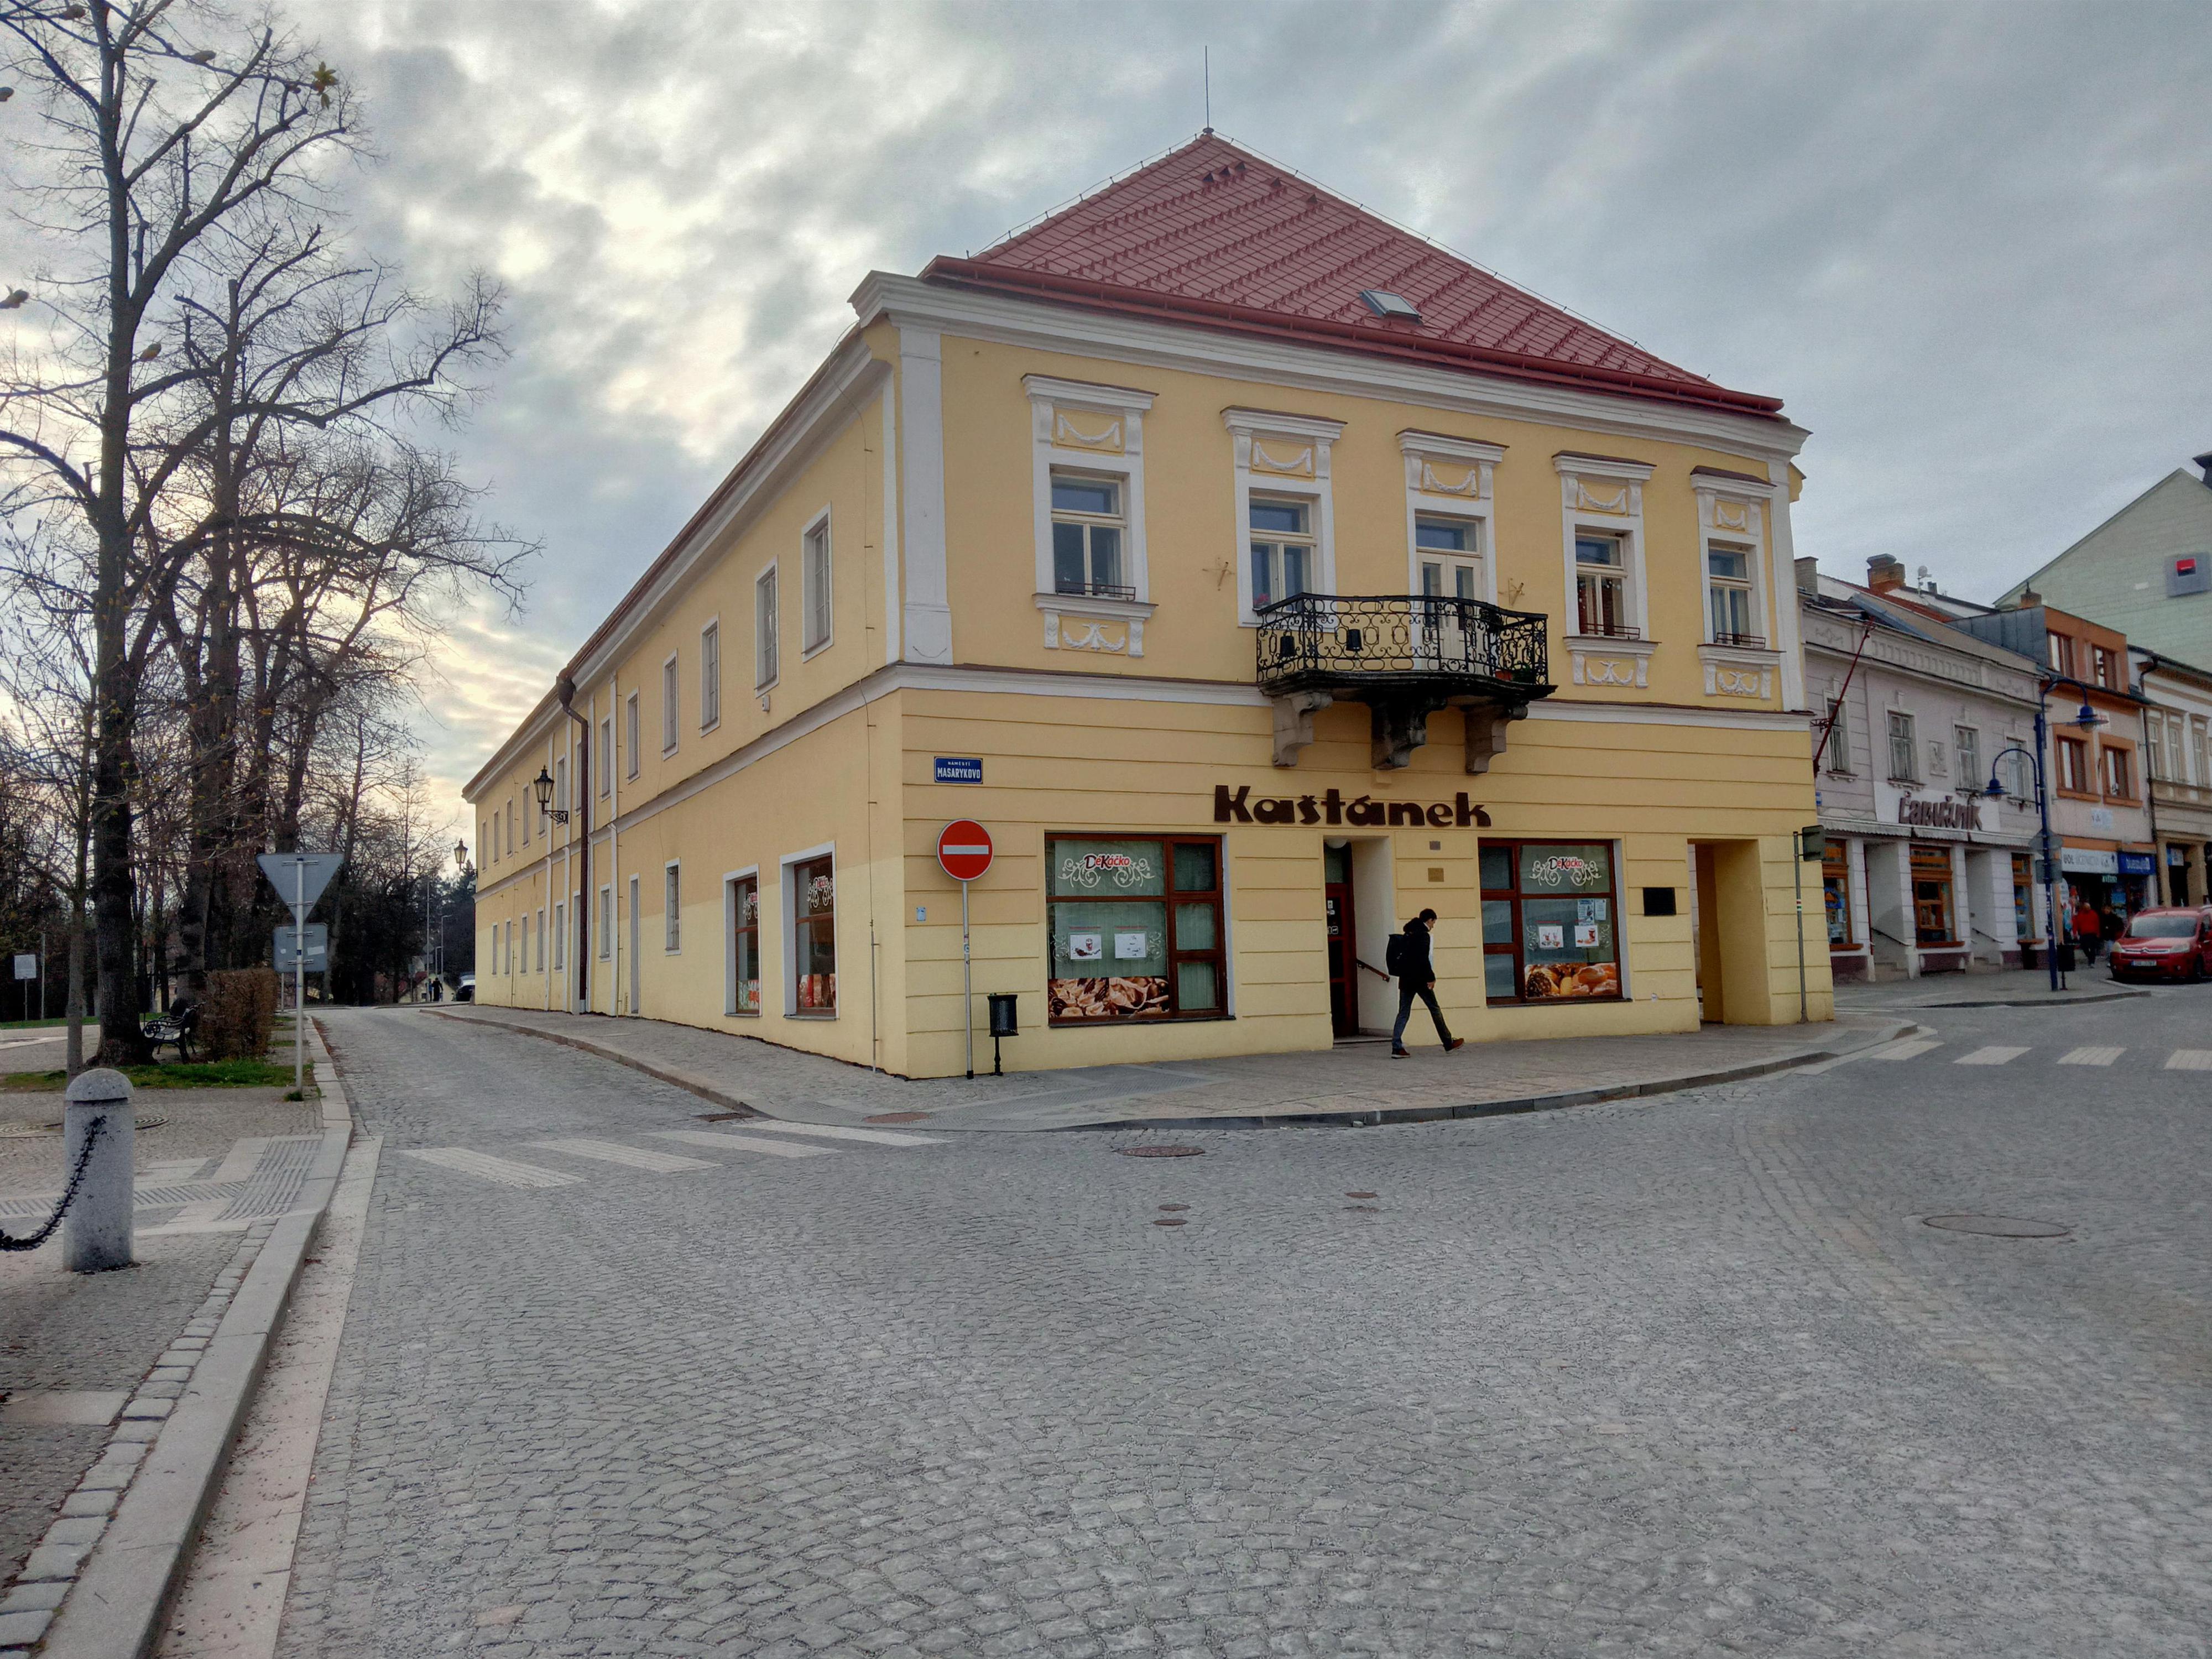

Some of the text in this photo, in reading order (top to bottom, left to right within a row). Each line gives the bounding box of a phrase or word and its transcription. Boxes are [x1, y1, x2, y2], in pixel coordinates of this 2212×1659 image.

[937, 768, 980, 779] MASARYKOVO
[1214, 785, 1491, 827] Kaštánek
[1084, 854, 1130, 870] DéKáčko
[1548, 857, 1583, 870] DéKáčko
